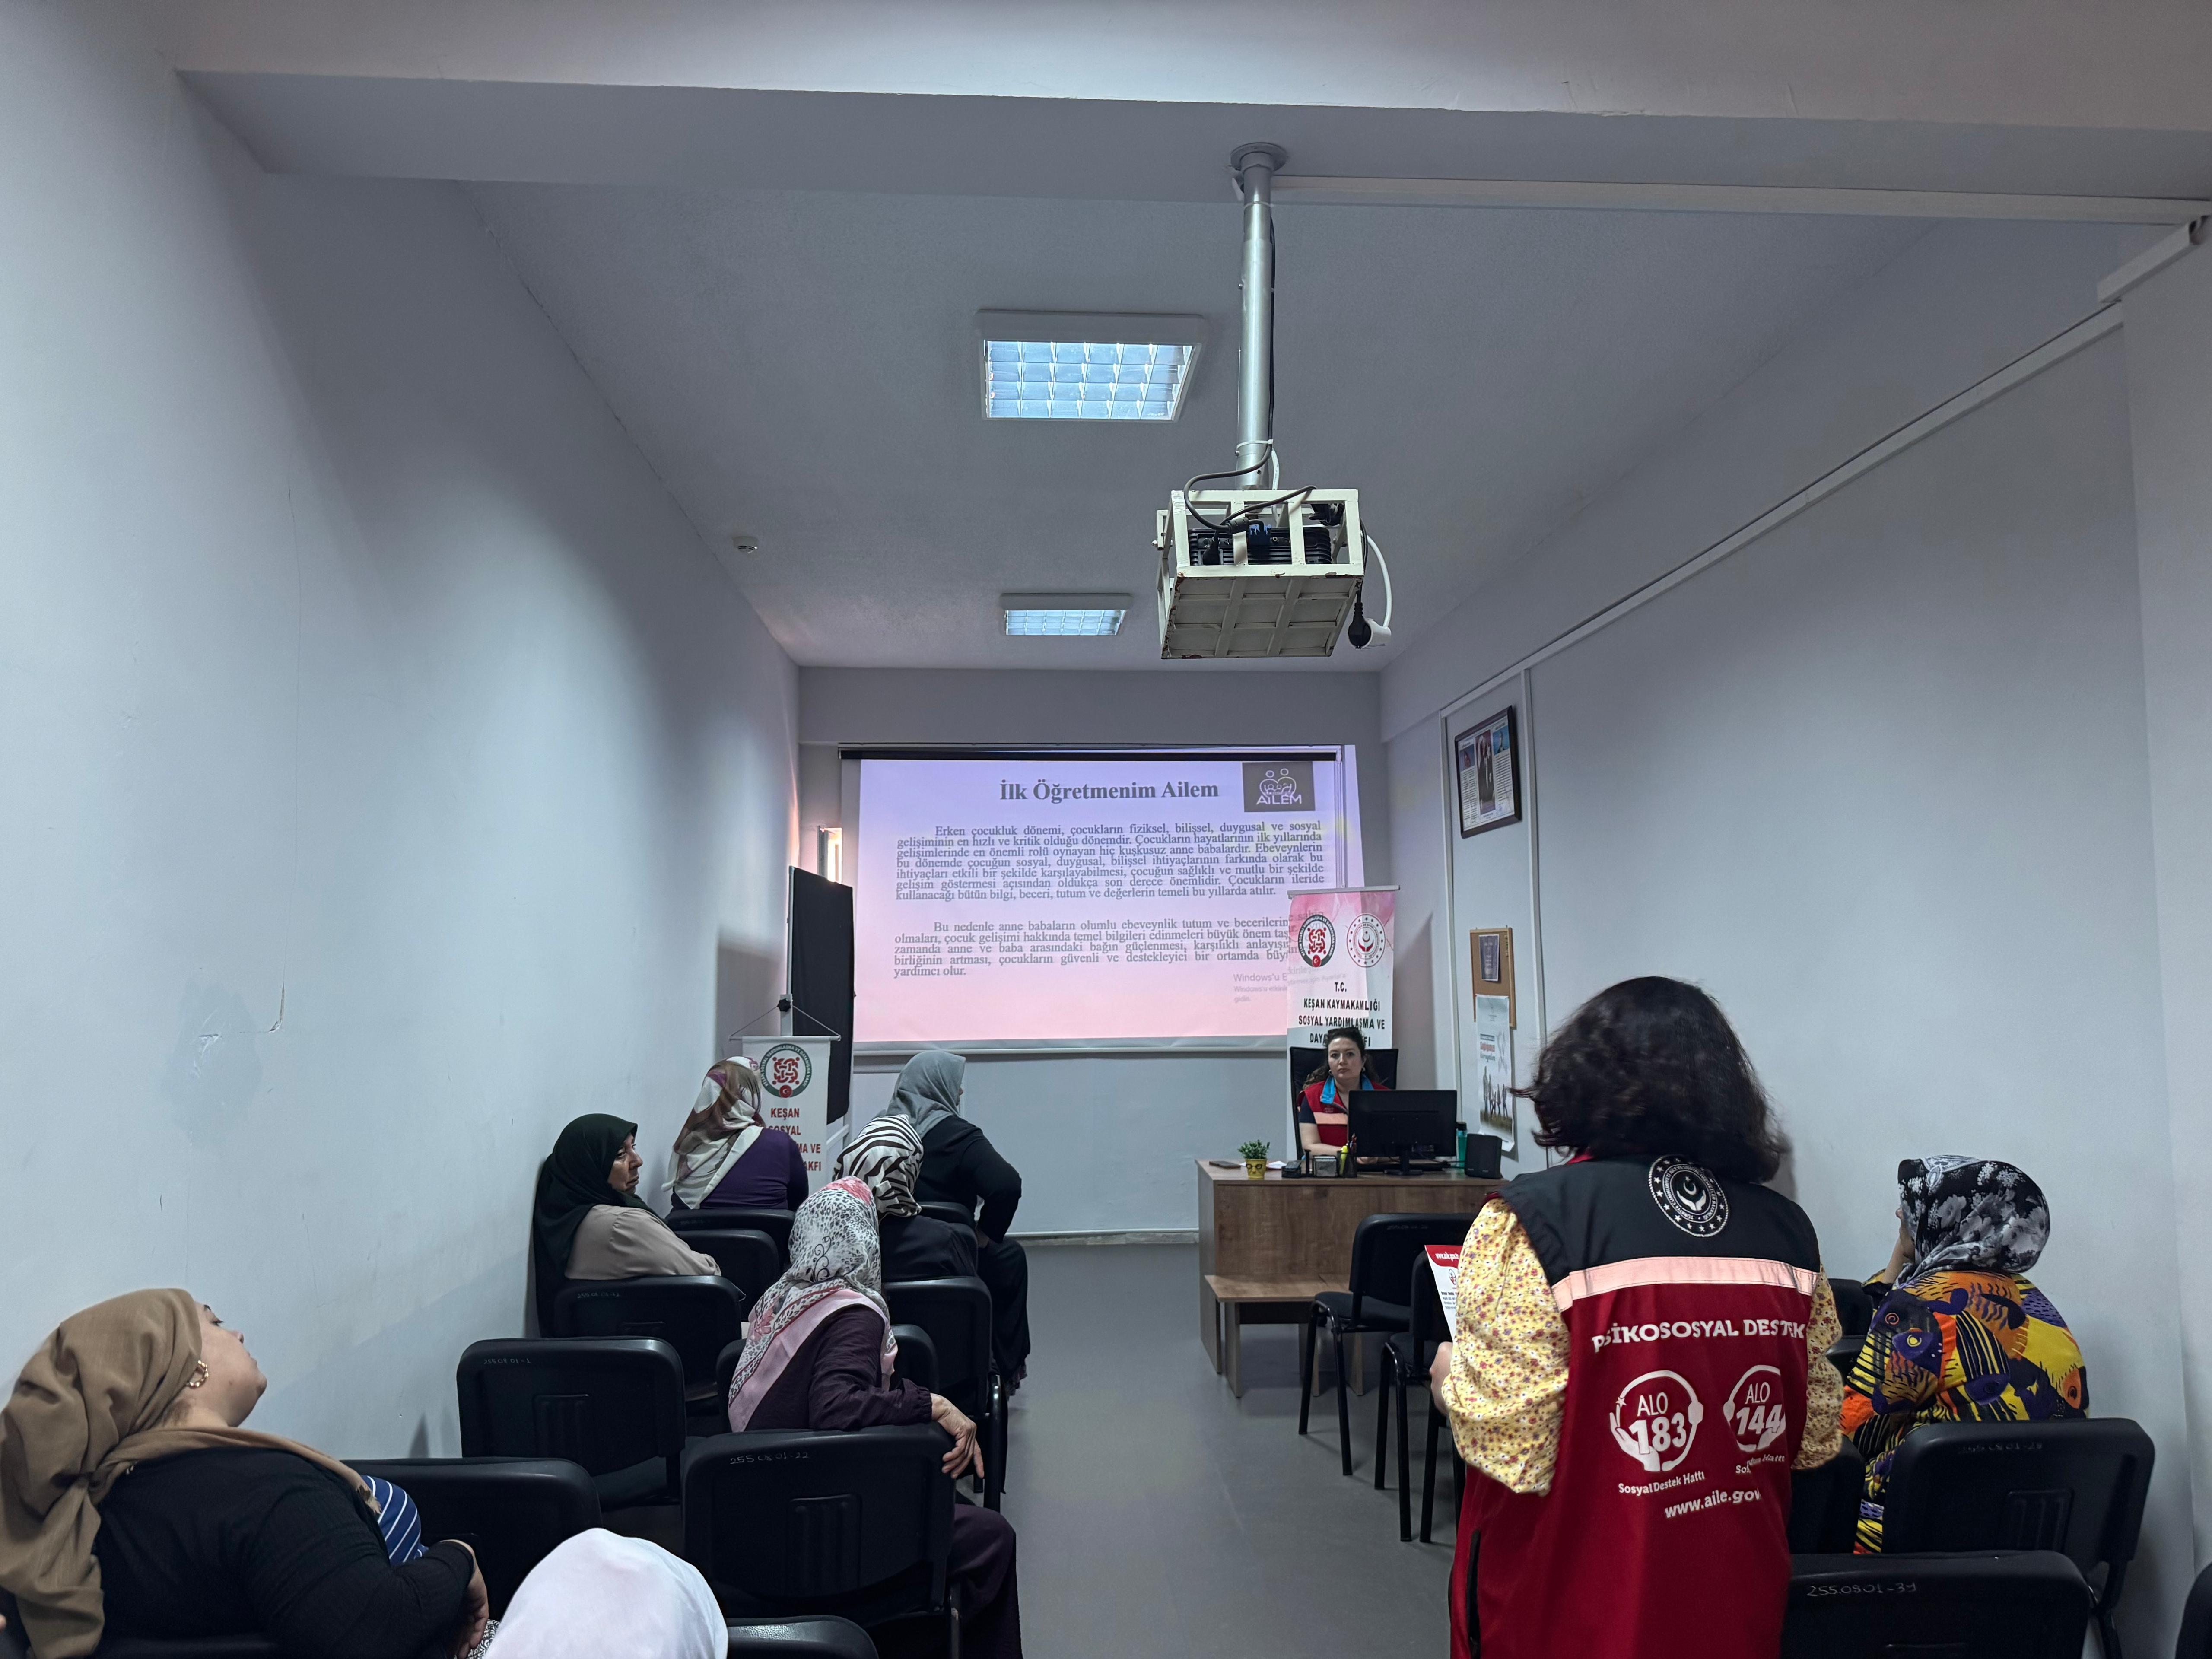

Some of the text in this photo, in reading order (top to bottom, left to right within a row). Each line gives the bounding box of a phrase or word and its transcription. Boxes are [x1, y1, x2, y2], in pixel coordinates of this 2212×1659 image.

[1000, 779, 1219, 804] İlk Öğretmenim Ailem
[935, 826, 966, 836] Erken
[971, 825, 1017, 838] çocukluk
[1023, 825, 1064, 836] dönemi,
[1070, 824, 1124, 837] çocukların
[1129, 823, 1169, 834] fiziksel,
[1175, 823, 1214, 835] bilişsel,
[1220, 822, 1265, 835] duygusal
[1290, 821, 1321, 834] sosyal
[898, 836, 954, 849] gelişiminin
[973, 836, 994, 845] hızlı
[1013, 836, 1040, 845] kritik
[1043, 835, 1079, 847] olduğu
[1081, 834, 1131, 844] dönemdir.
[1135, 834, 1191, 846] Çocukların
[1194, 833, 1254, 845] hayatlarının
[1257, 832, 1271, 842] ilk
[1273, 831, 1322, 844] yıllarında
[897, 847, 969, 860] gelişimlerinde
[989, 847, 1024, 856] önemli
[1028, 846, 1049, 856] rolü
[1053, 849, 1095, 858] oynayan
[1100, 846, 1115, 858] hiç
[1119, 845, 1166, 858] kuşkusuz
[1198, 843, 1250, 854] babalardır.
[1255, 842, 1322, 855] Ebeveynlerin
[897, 852, 1322, 869] bu dönemde çocuğun sosyal, duygusal, bilişsel ihtiyaçlarının farkında olarak bu
[896, 868, 947, 881] ihtiyaçları
[952, 868, 978, 878] etkili
[983, 868, 997, 877] bir
[1001, 868, 1036, 880] şekilde
[1041, 866, 1126, 880] karşılayabilmesi,
[1131, 865, 1173, 878] çocuğun
[1178, 864, 1214, 877] sağlıklı
[1235, 864, 1265, 874] mutlu
[1269, 864, 1284, 873] bir
[1287, 863, 1324, 875] şekilde
[896, 879, 934, 891] gelişim
[941, 878, 996, 891] göstermesi
[1003, 878, 1052, 890] açısından
[1058, 877, 1098, 890] oldukça
[1130, 877, 1163, 886] derece
[1170, 875, 1220, 886] önemlidir.
[1228, 874, 1285, 887] Çocukların
[1292, 874, 1324, 884] ileride
[896, 890, 954, 902] kullanacağı
[958, 890, 987, 899] bütün
[990, 889, 1016, 902] bilgi,
[1020, 889, 1053, 900] beceri,
[1104, 887, 1155, 900] değerlerin
[1158, 887, 1189, 896] temeli
[1193, 887, 1205, 896] bu
[1208, 886, 1247, 899] yıllarda
[1250, 885, 1276, 895] atılır.
[934, 923, 948, 931] Bu
[954, 921, 994, 931] nedenle
[1029, 921, 1075, 930] babaların
[1081, 920, 1116, 930] olumlu
[1122, 919, 1177, 931] ebeveynlik
[895, 933, 941, 944] olmaları,
[944, 933, 975, 945] çocuk
[979, 932, 1019, 945] gelişimi
[1023, 931, 1070, 941] hakkında
[1074, 931, 1101, 941] temel
[1106, 931, 1145, 943] bilgileri
[1149, 929, 1204, 940] edinmeleri
[1208, 929, 1239, 941] büyük
[1243, 929, 1271, 938] önem
[894, 944, 941, 953] zamanda
[999, 943, 1023, 953] baba
[1030, 942, 1084, 952] arasındaki
[1090, 942, 1118, 954] bağın
[1125, 941, 1187, 954] güçlenmesi,
[1194, 940, 1239, 952] karşılıklı
[894, 955, 942, 968] birliğinin
[950, 957, 991, 966] artması,
[999, 953, 1054, 966] çocukların
[1061, 953, 1099, 966] güvenli
[1126, 951, 1187, 964] destekleyici
[1195, 951, 1209, 961] bir
[1217, 950, 1259, 960] ortamda
[894, 966, 966, 979] yardımcı olur.
[1233, 973, 1279, 982] Windows'u
[1335, 982, 1347, 992] T.C.
[1304, 998, 1380, 1011] KEŞAN KAYMAKAMLIĞI
[1299, 1015, 1385, 1029] SOSYAL YARDIMLAŞMA VE
[771, 1108, 799, 1120] KEŞAN
[769, 1125, 801, 1135] SYAL
[810, 1144, 821, 1153] VE
[1745, 1382, 1770, 1404] ALO
[1637, 1392, 1668, 1417] ALO
[1736, 1404, 1783, 1435] 144
[1629, 1412, 1686, 1454] 183
[1618, 1471, 1705, 1497] Sosyal Destek Hattı
